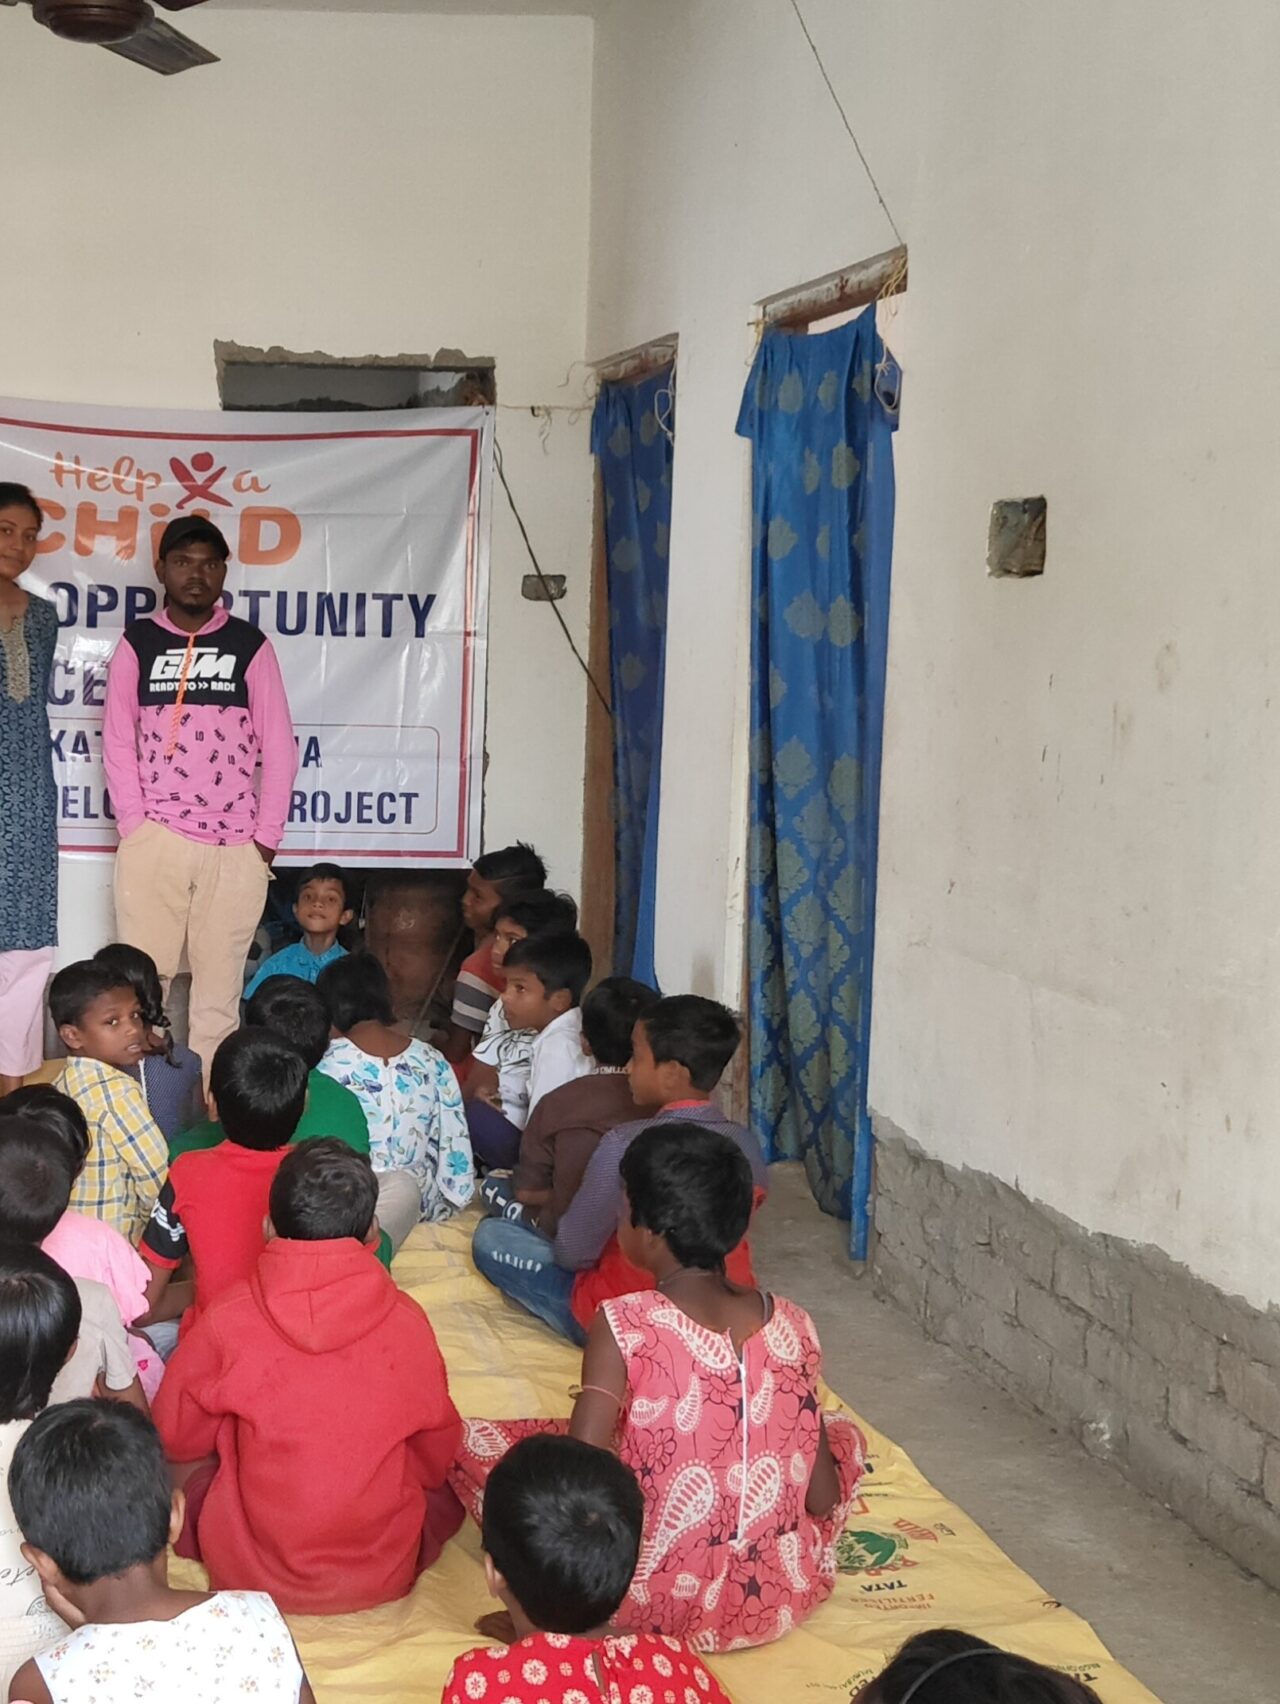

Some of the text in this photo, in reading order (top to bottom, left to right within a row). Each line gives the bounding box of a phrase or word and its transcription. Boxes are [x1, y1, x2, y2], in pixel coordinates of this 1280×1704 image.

[50, 451, 271, 501] Help a
[47, 581, 437, 638] OPPTUNITY
[287, 790, 419, 825] ROJECT
[861, 1579, 908, 1593] TATA
